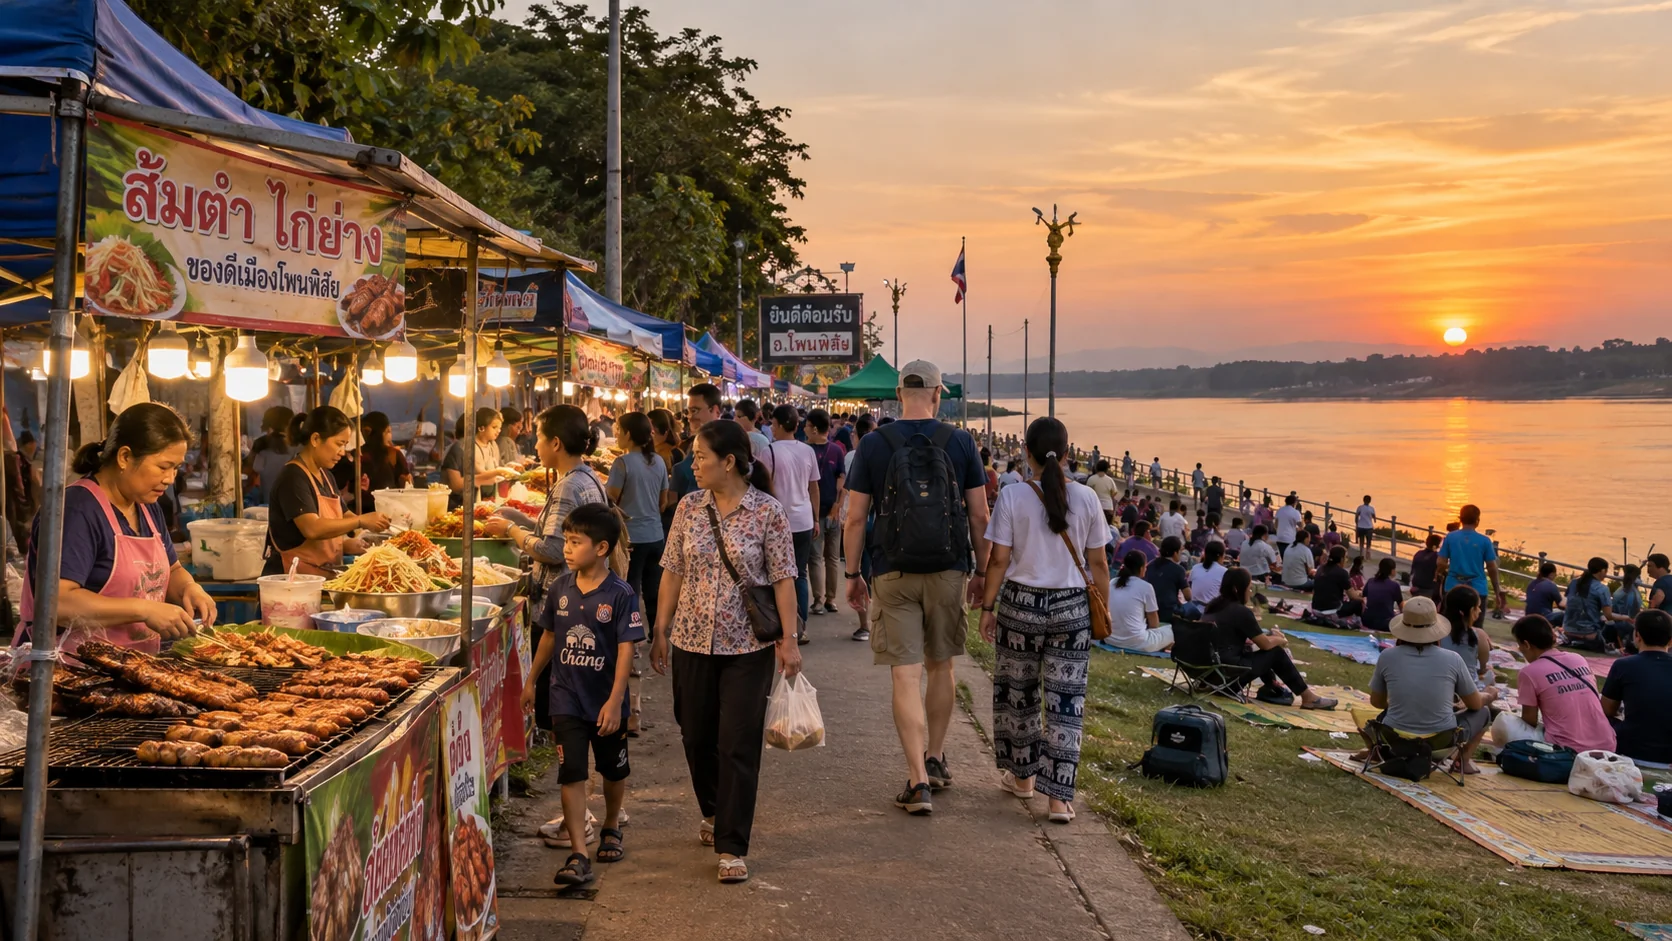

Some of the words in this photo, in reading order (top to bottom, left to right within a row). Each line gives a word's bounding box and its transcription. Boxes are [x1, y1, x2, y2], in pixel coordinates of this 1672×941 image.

[123, 147, 255, 243] ส้มตำ
[265, 177, 383, 266] ไก่ย่าง
[559, 647, 606, 671] Chang
